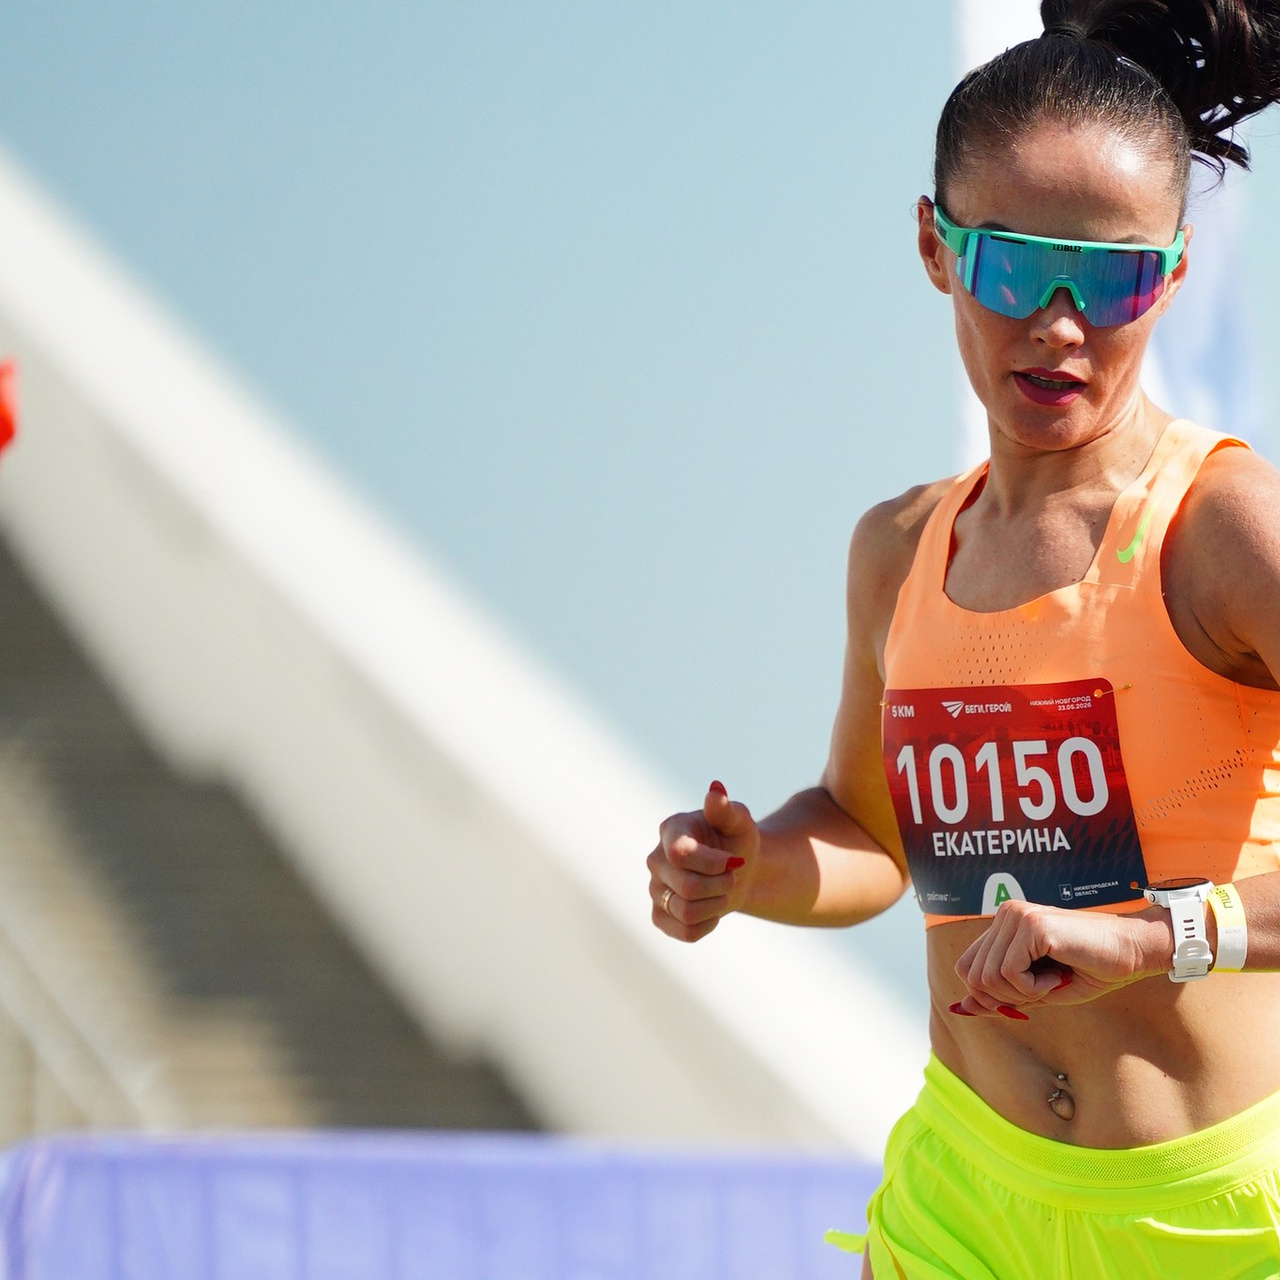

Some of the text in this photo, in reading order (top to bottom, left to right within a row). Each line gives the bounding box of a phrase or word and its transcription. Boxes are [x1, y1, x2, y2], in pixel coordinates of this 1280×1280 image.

[1055, 695, 1091, 705] НОВГОРОД
[896, 737, 1109, 824] 10150
[932, 827, 1071, 857] ЕКАТЕРИНА
[1074, 889, 1099, 897] ОБЛАСТЬ
